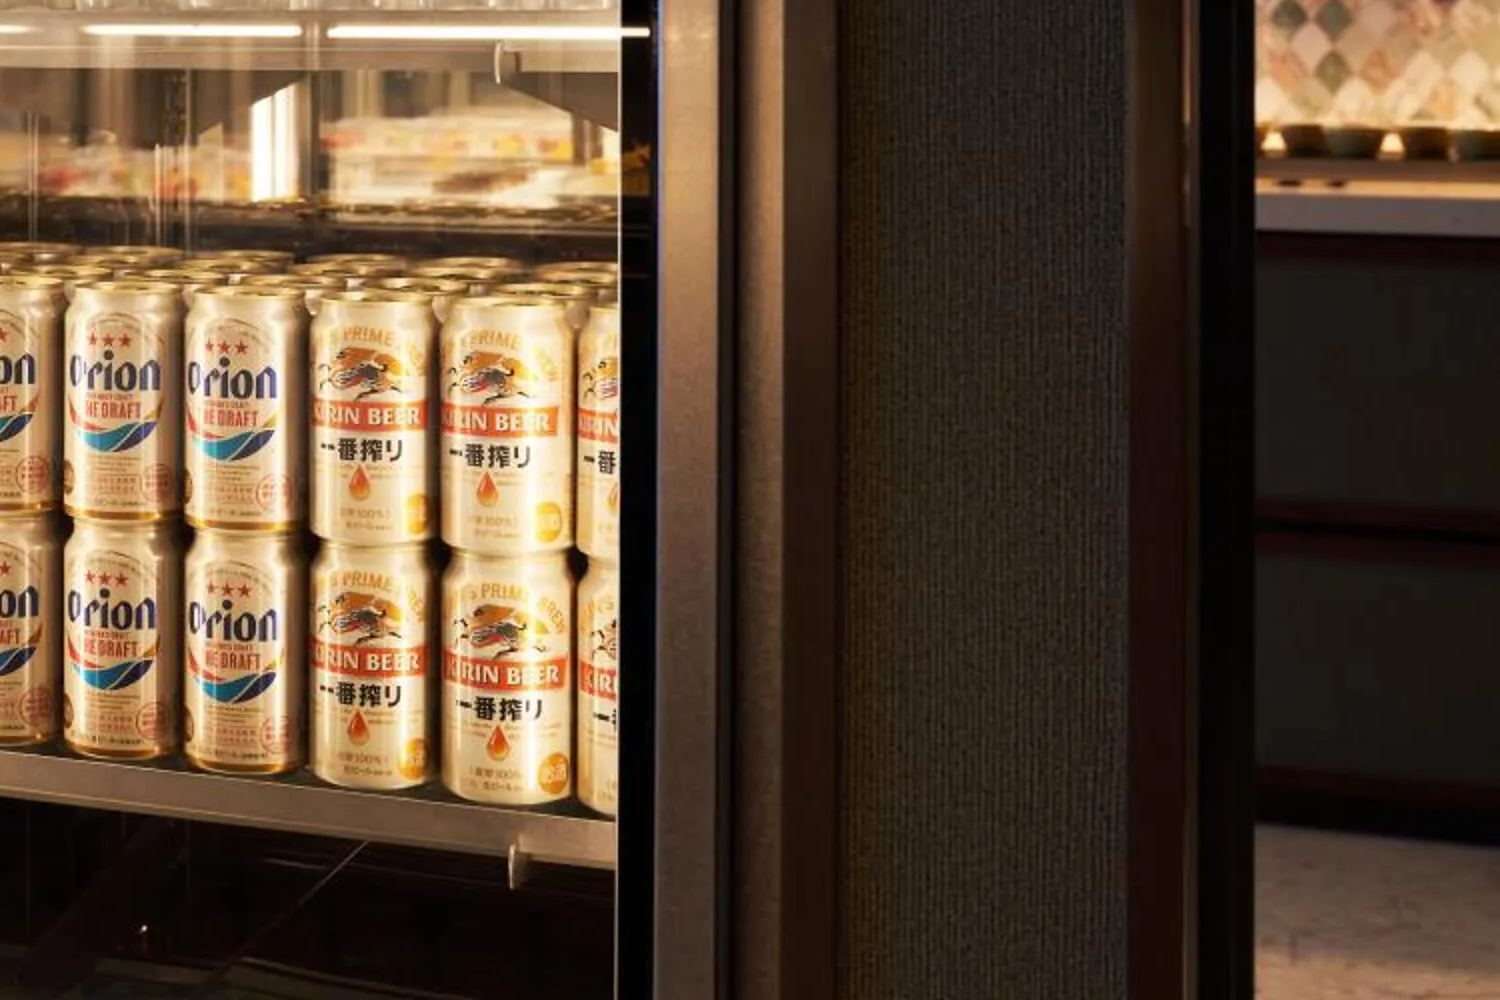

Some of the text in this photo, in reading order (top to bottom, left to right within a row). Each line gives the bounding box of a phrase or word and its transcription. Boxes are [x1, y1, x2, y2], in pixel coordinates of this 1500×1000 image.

[343, 326, 393, 346] PRIME
[69, 349, 161, 391] Orion
[188, 356, 277, 399] Orion
[101, 401, 142, 419] DRAFT
[217, 408, 258, 427] DRAFT
[314, 401, 420, 426] KRIN BEER
[494, 411, 550, 433] BEER
[320, 438, 403, 464] 一番搾り
[449, 443, 532, 469] 一番搾り
[67, 587, 157, 631] Orion
[188, 599, 278, 643] Orion
[98, 640, 139, 658] DRAFT
[219, 652, 262, 671] DRAFT
[314, 644, 420, 672] KRIN BEER
[446, 655, 499, 683] KRIN
[319, 681, 402, 708] 一番搾り
[456, 696, 543, 722] 一番搾り
